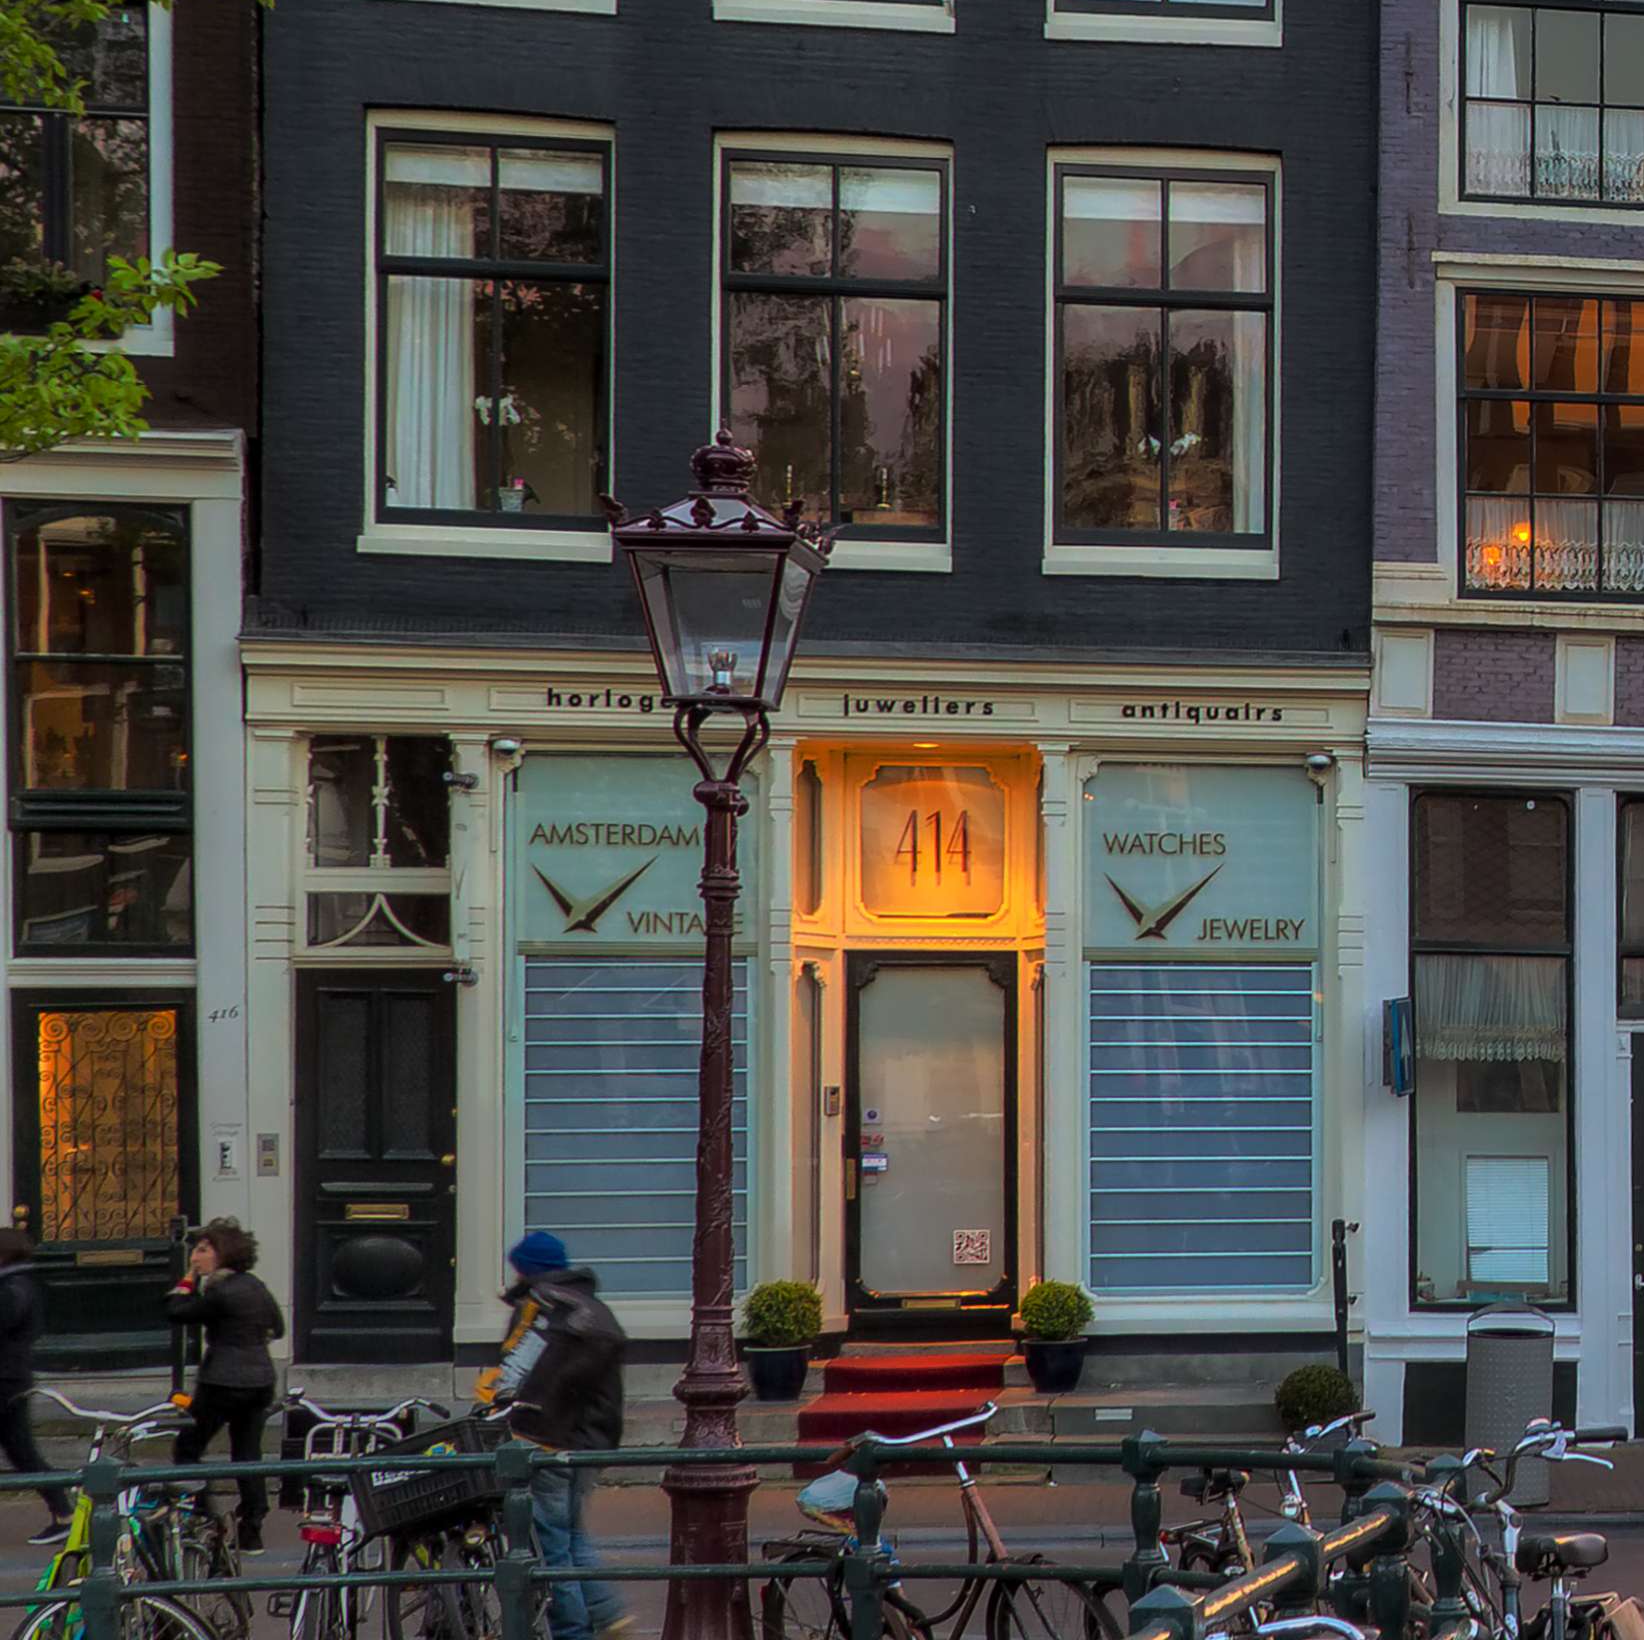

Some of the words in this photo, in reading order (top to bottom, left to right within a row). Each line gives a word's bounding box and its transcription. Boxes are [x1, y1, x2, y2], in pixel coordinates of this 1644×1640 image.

[844, 693, 994, 716] juweliers
[1121, 700, 1283, 724] antiquairs
[528, 823, 700, 847] AMSTERDAM
[895, 809, 972, 873] 414
[1102, 832, 1227, 856] WATCHES
[626, 911, 743, 935] VINTAE
[1197, 918, 1306, 941] JEWELRY
[208, 1004, 239, 1023] 416
